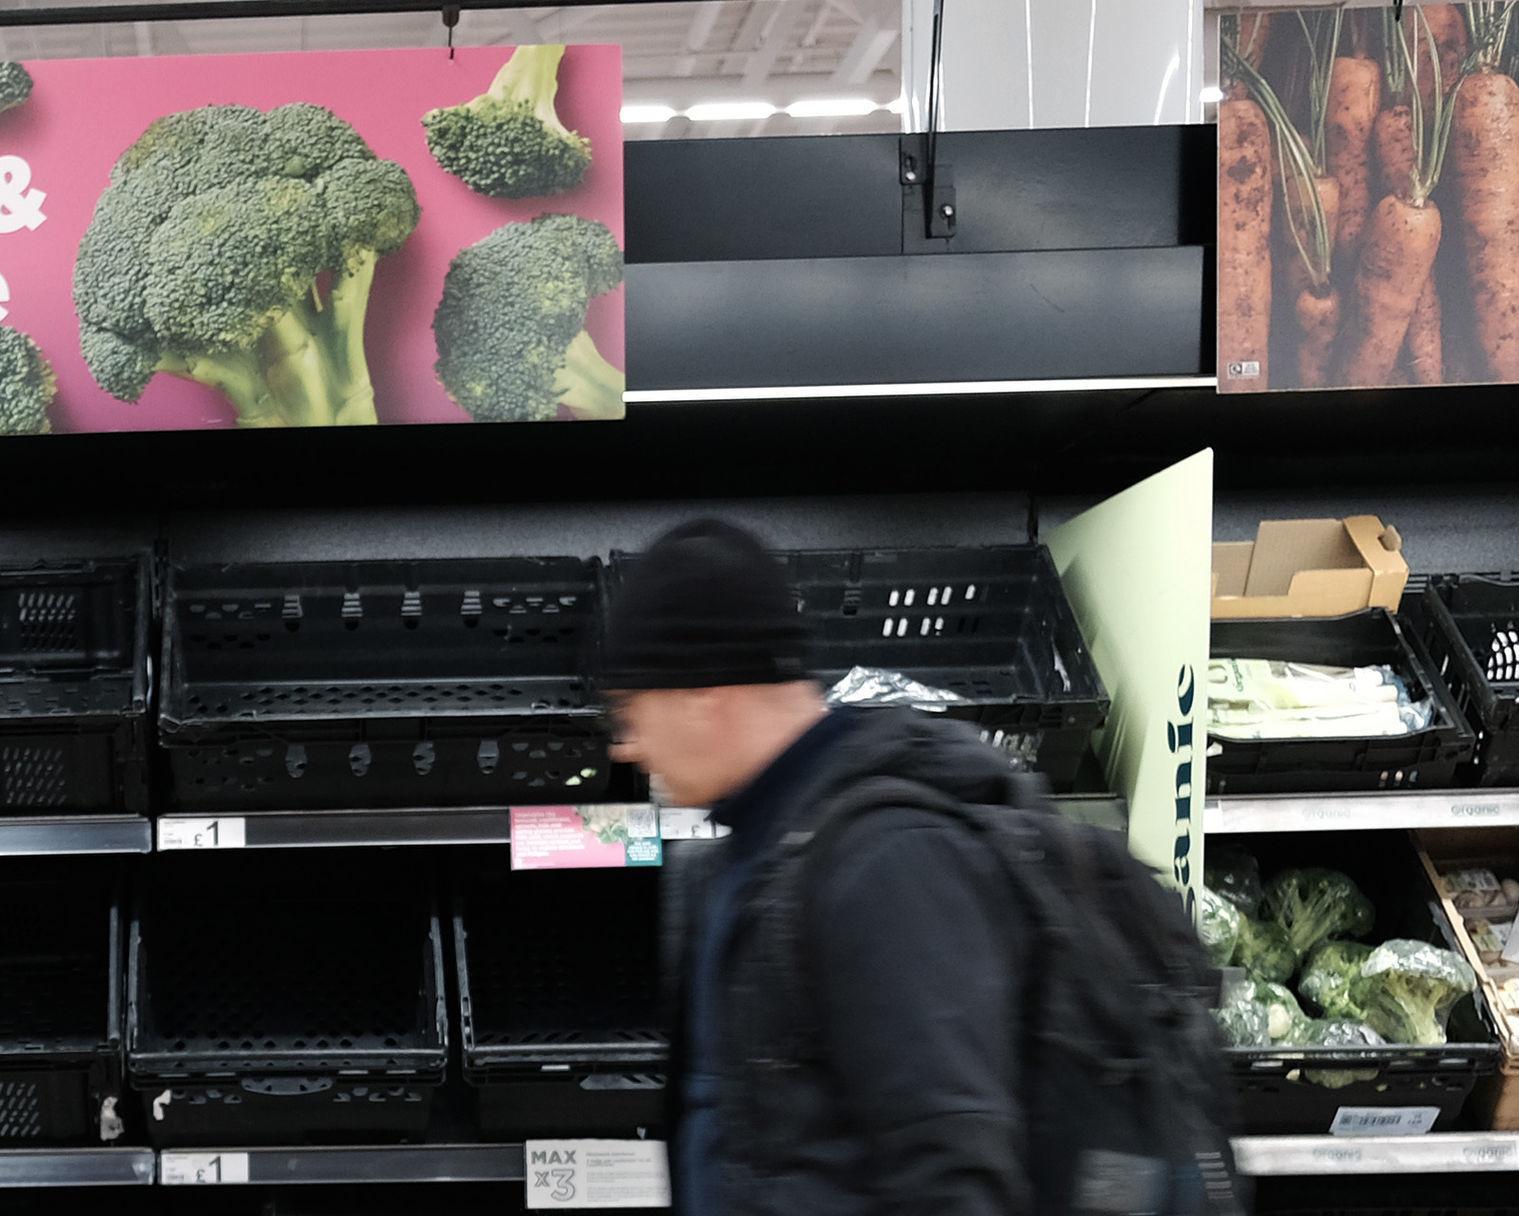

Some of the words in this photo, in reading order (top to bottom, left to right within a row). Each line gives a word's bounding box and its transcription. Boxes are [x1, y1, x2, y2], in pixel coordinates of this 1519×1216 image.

[1167, 663, 1198, 912] anic
[193, 820, 220, 847] £1
[195, 1155, 223, 1184] £1
[530, 1149, 577, 1165] MAX
